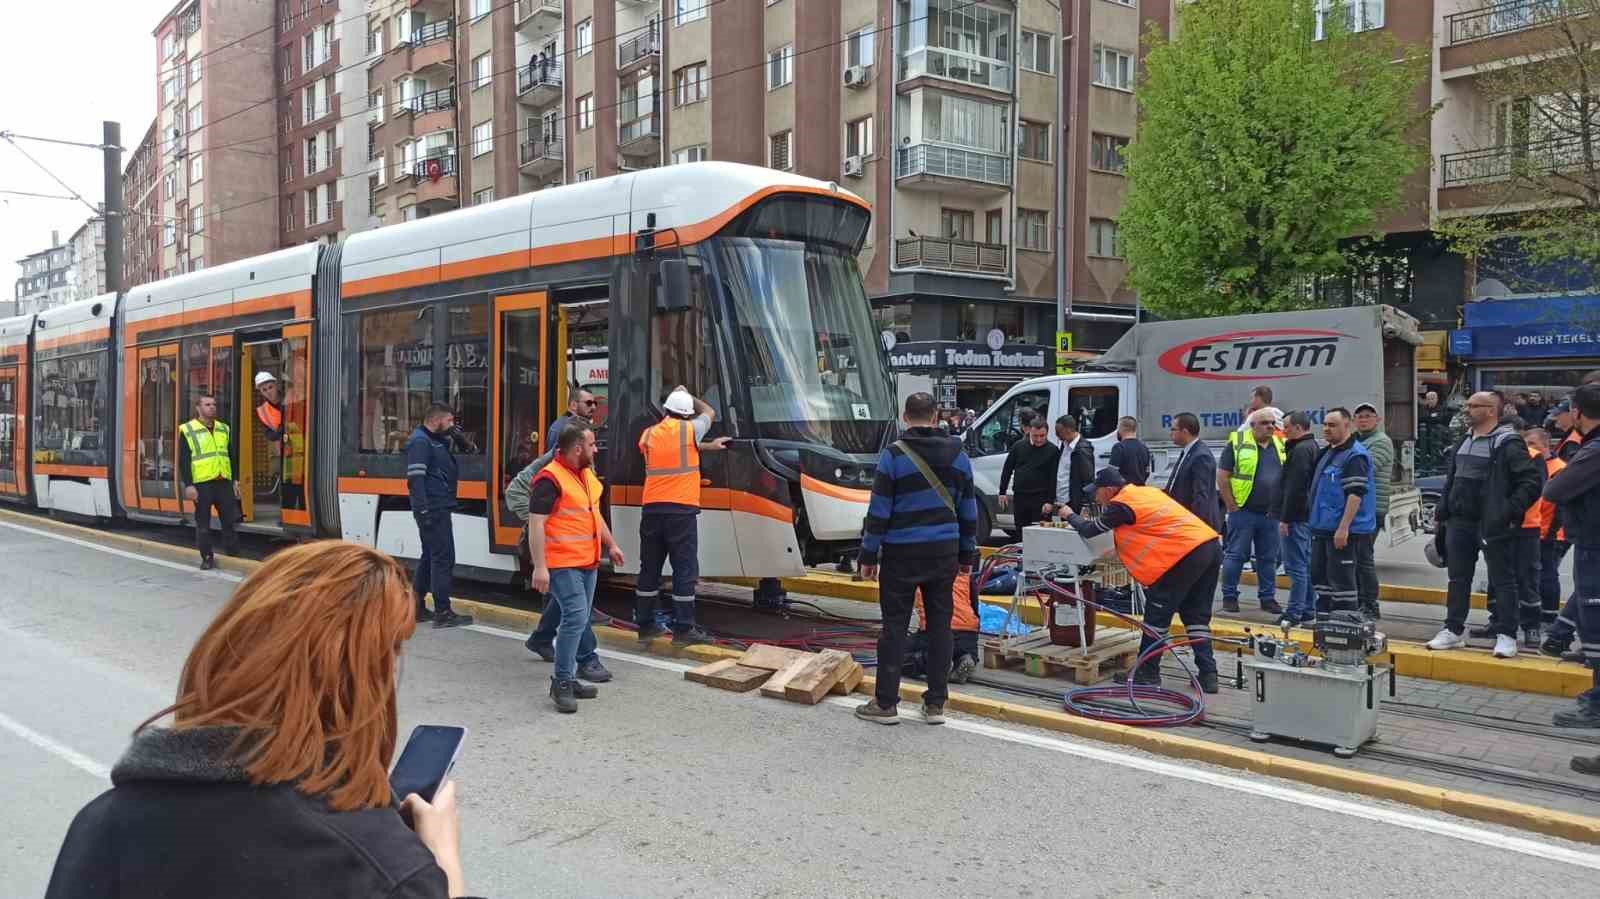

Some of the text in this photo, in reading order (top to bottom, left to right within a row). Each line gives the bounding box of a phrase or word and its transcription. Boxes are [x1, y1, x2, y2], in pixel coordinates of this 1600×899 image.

[1513, 336, 1553, 346] JOKER
[1555, 334, 1594, 344] TEKEL
[887, 349, 936, 366] antuni
[991, 350, 1045, 368] Tantuni
[1185, 337, 1339, 373] EsTram
